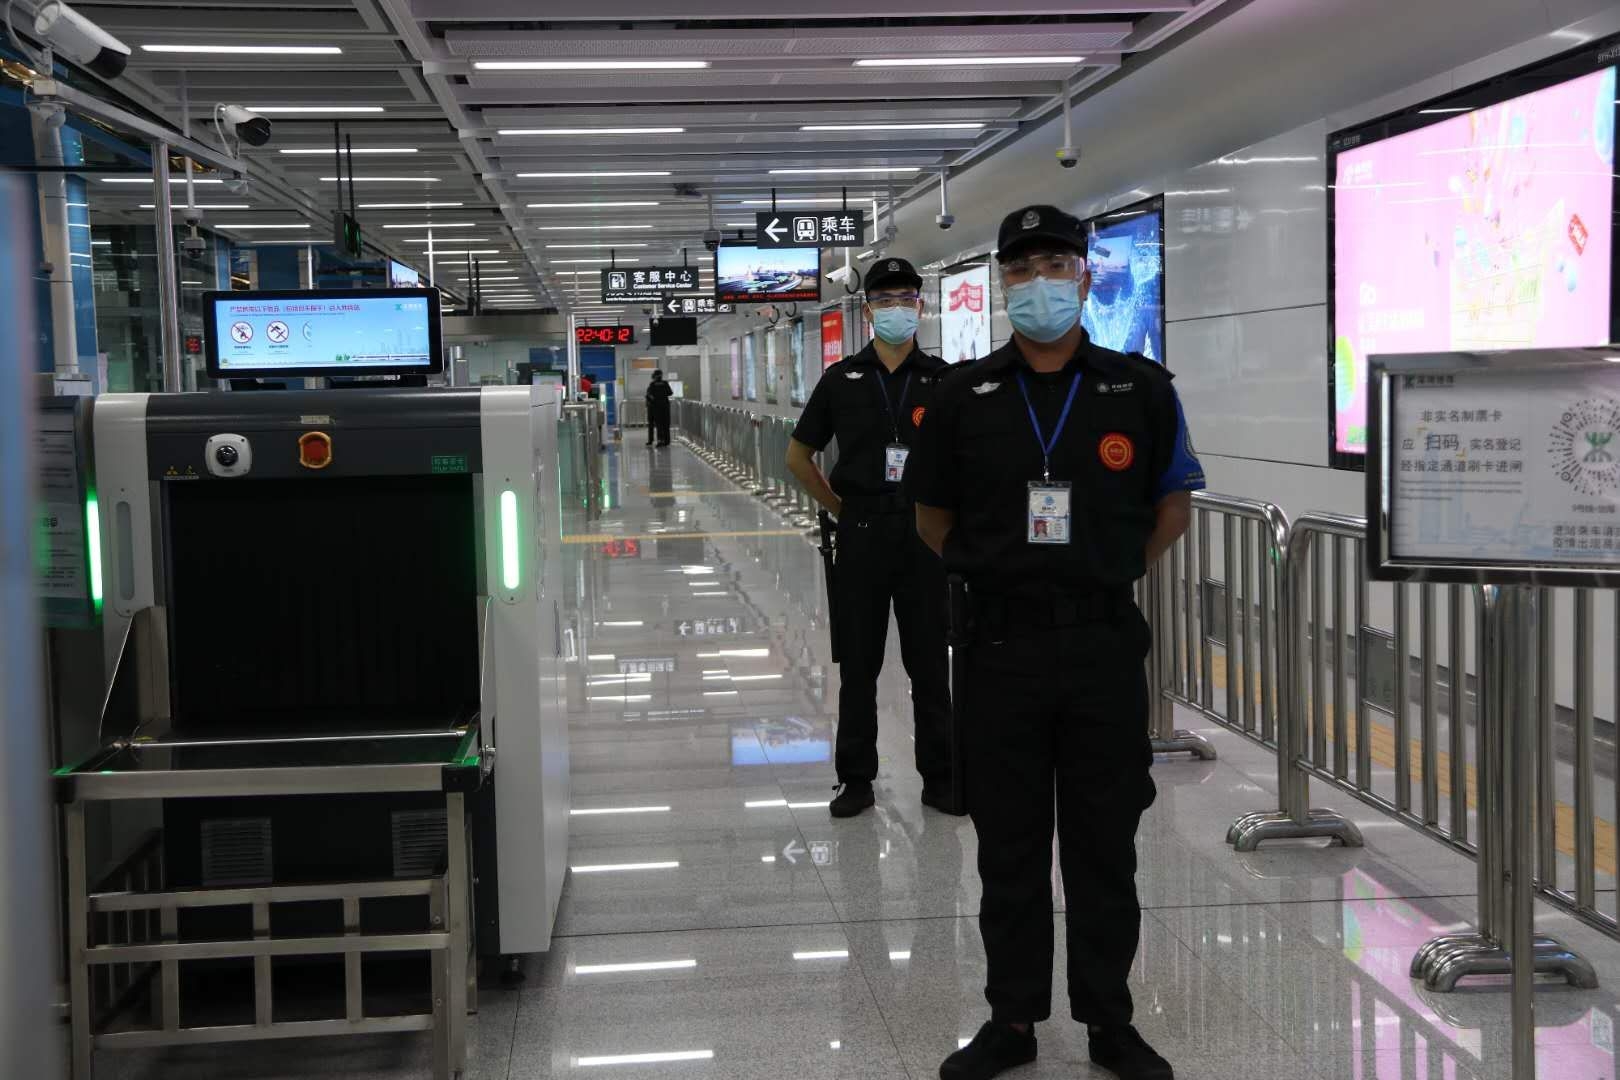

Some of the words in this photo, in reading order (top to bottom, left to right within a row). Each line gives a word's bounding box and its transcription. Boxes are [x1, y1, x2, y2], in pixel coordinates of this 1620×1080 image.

[821, 216, 856, 233] 乘车
[821, 234, 832, 242] To
[834, 233, 855, 241] Train
[633, 270, 692, 283] 客服中心
[1422, 410, 1503, 422] 非实名制票卡
[1401, 438, 1415, 450] 应
[1425, 434, 1460, 451] 扫码
[1470, 438, 1522, 451] 实名登记
